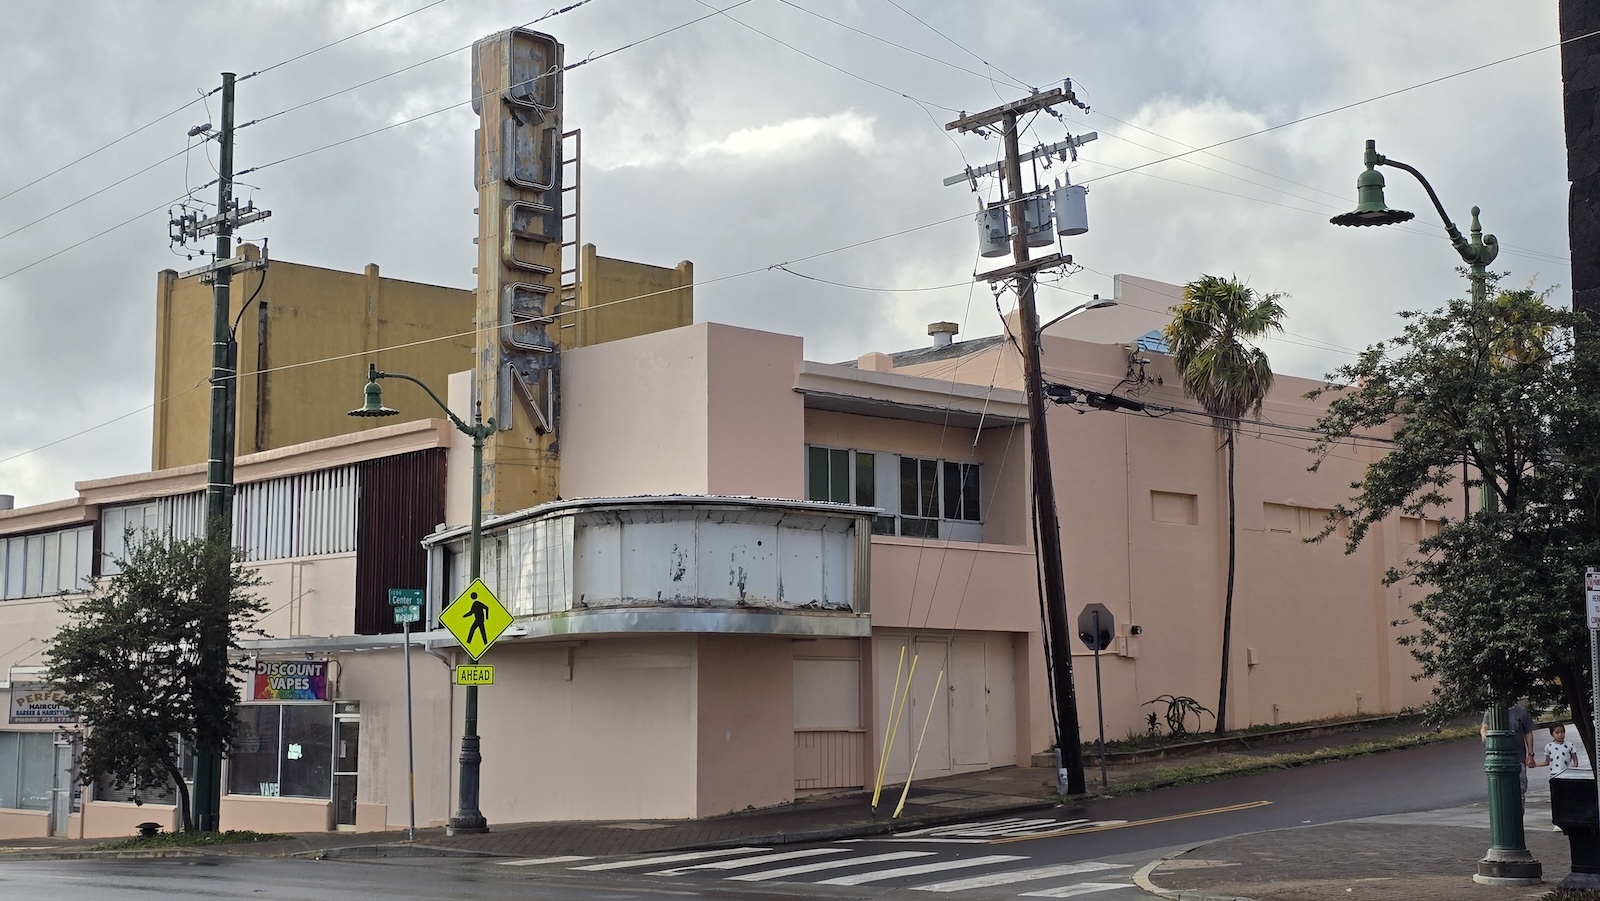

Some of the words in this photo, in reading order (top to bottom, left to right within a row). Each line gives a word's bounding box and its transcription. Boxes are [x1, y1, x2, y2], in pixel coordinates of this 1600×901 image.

[502, 28, 557, 433] QUEEN
[392, 595, 413, 604] Center
[257, 663, 323, 676] DISCOUNT
[461, 670, 490, 681] AHEAD
[269, 676, 310, 690] VAPES
[259, 782, 279, 796] VAPE
